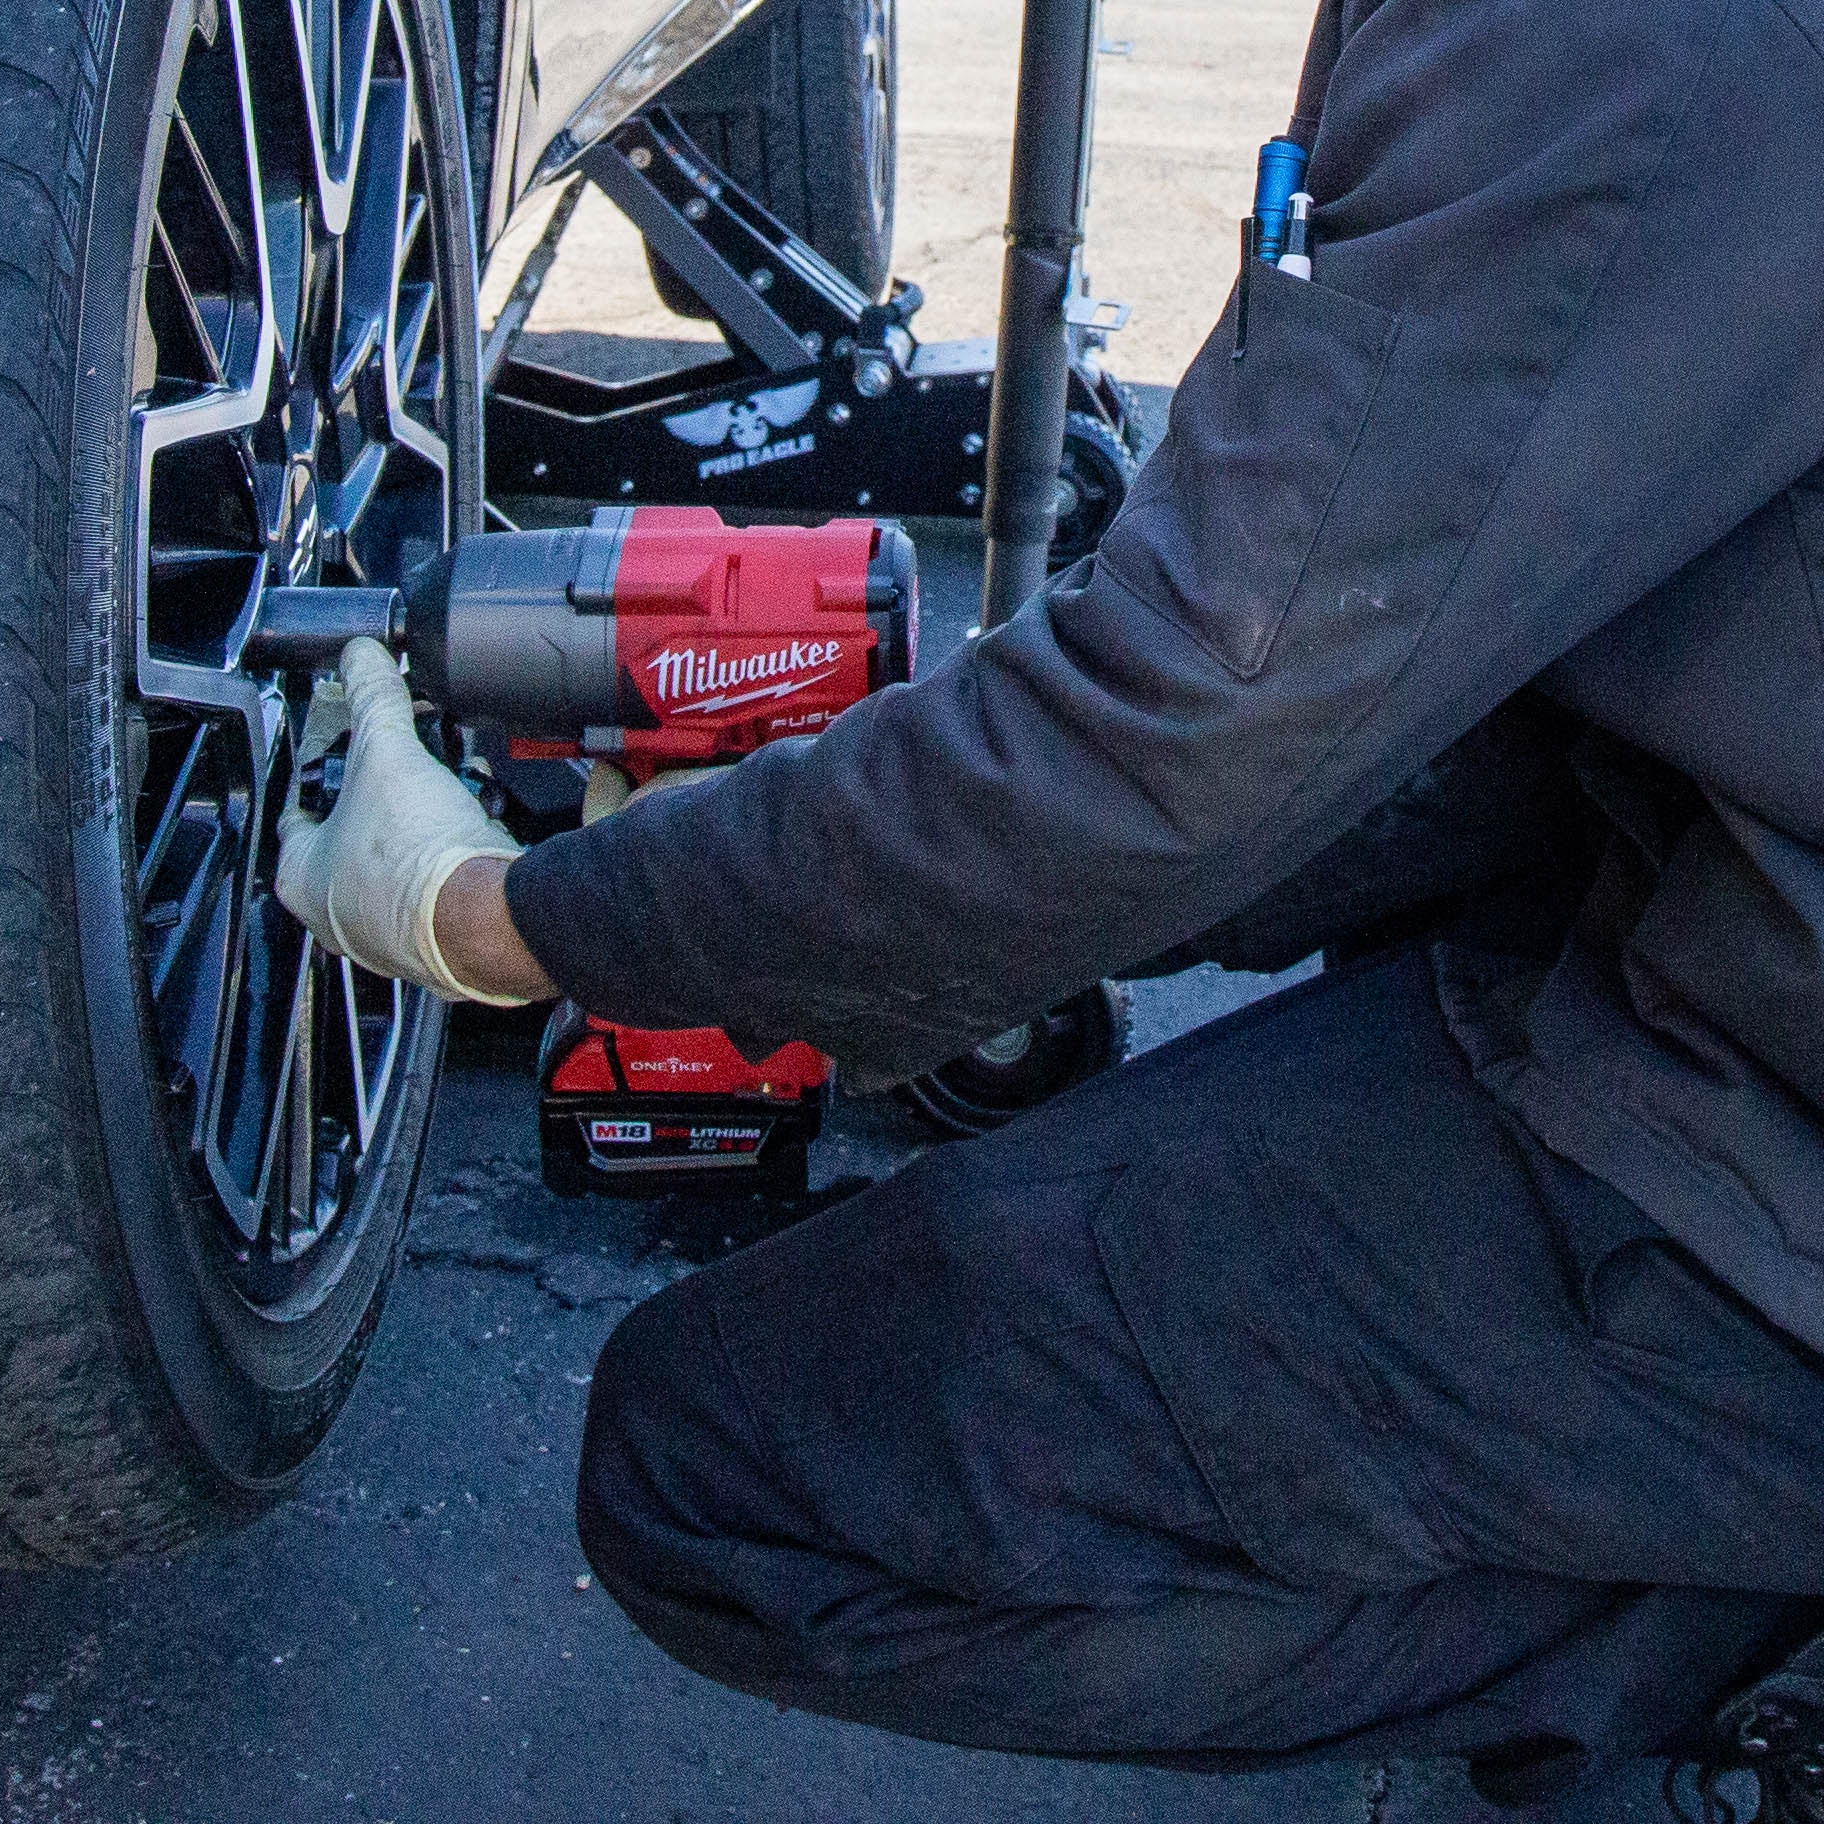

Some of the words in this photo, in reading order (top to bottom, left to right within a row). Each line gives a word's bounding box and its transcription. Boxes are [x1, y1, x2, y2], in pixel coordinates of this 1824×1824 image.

[646, 640, 843, 701] Milwaukee
[771, 710, 840, 729] FUEL
[679, 1061, 714, 1073] KEY
[595, 1125, 647, 1139] M18
